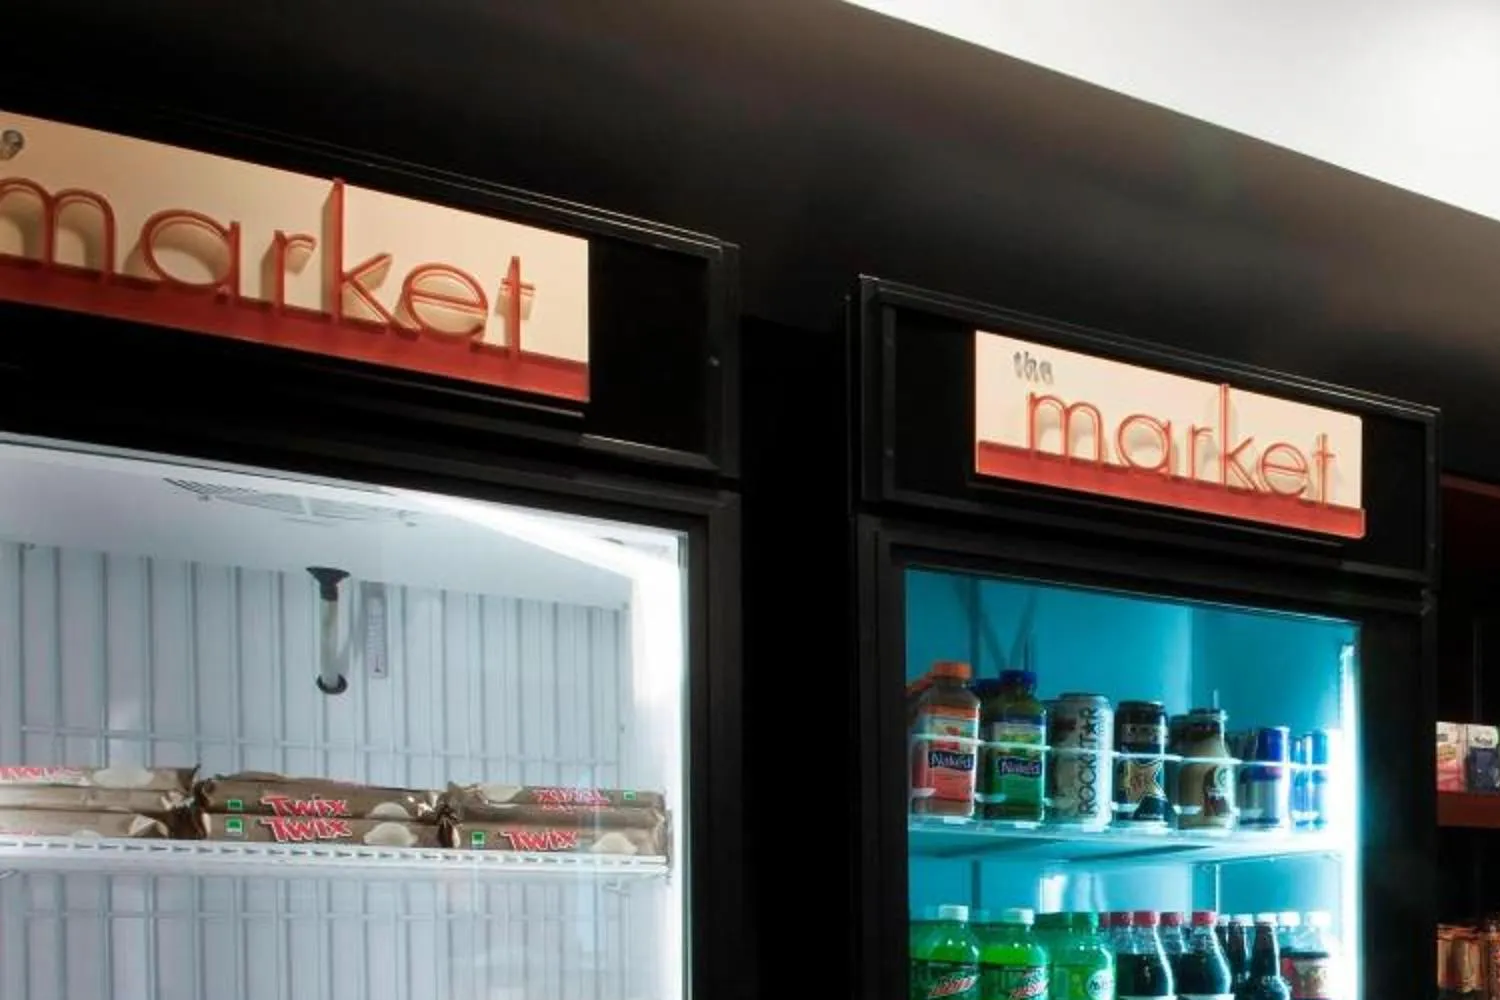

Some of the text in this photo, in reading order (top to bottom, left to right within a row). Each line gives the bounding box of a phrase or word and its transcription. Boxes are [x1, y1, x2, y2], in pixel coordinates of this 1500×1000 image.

[0, 177, 537, 358] market
[1012, 351, 1055, 385] the
[1026, 383, 1336, 504] market
